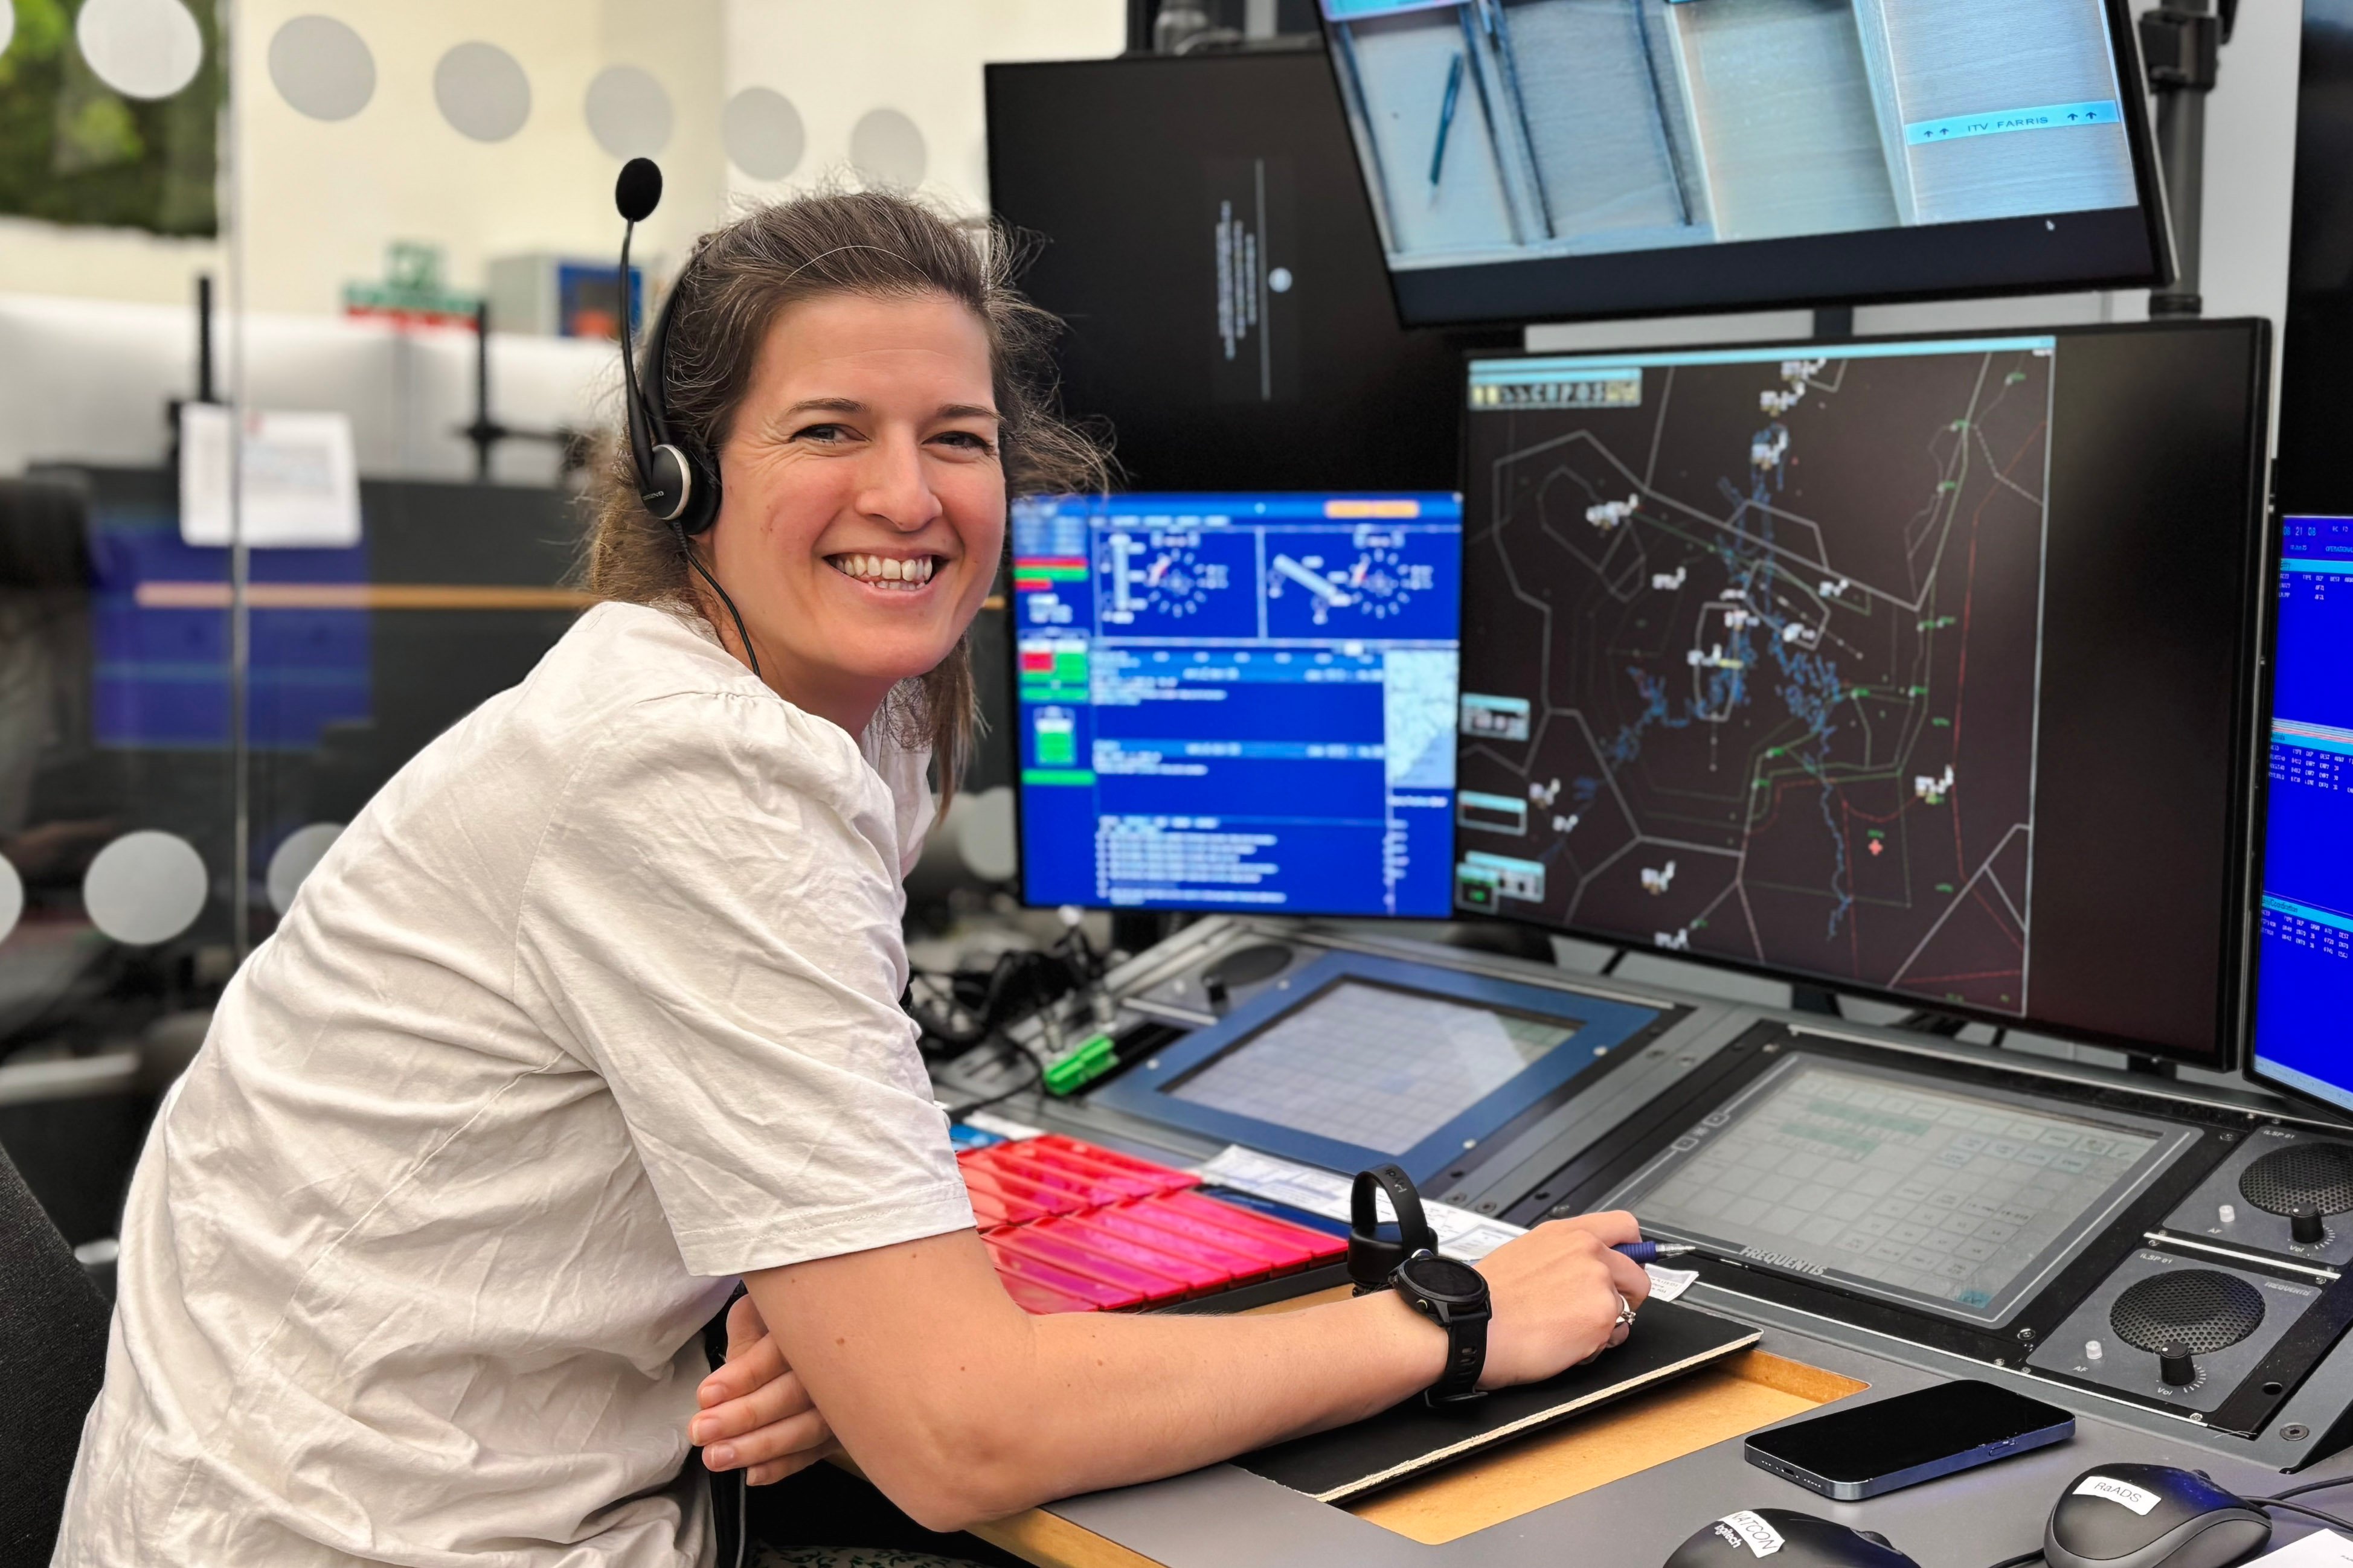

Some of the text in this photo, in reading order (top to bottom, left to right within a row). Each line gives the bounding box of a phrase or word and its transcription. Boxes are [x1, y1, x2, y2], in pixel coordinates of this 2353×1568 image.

[1968, 117, 2048, 132] ITV FARRIS
[2295, 526, 2302, 536] 21
[1739, 1246, 1828, 1276] FREQUENTIS
[2157, 1387, 2174, 1396] Vol
[2093, 1482, 2142, 1503] RaADS
